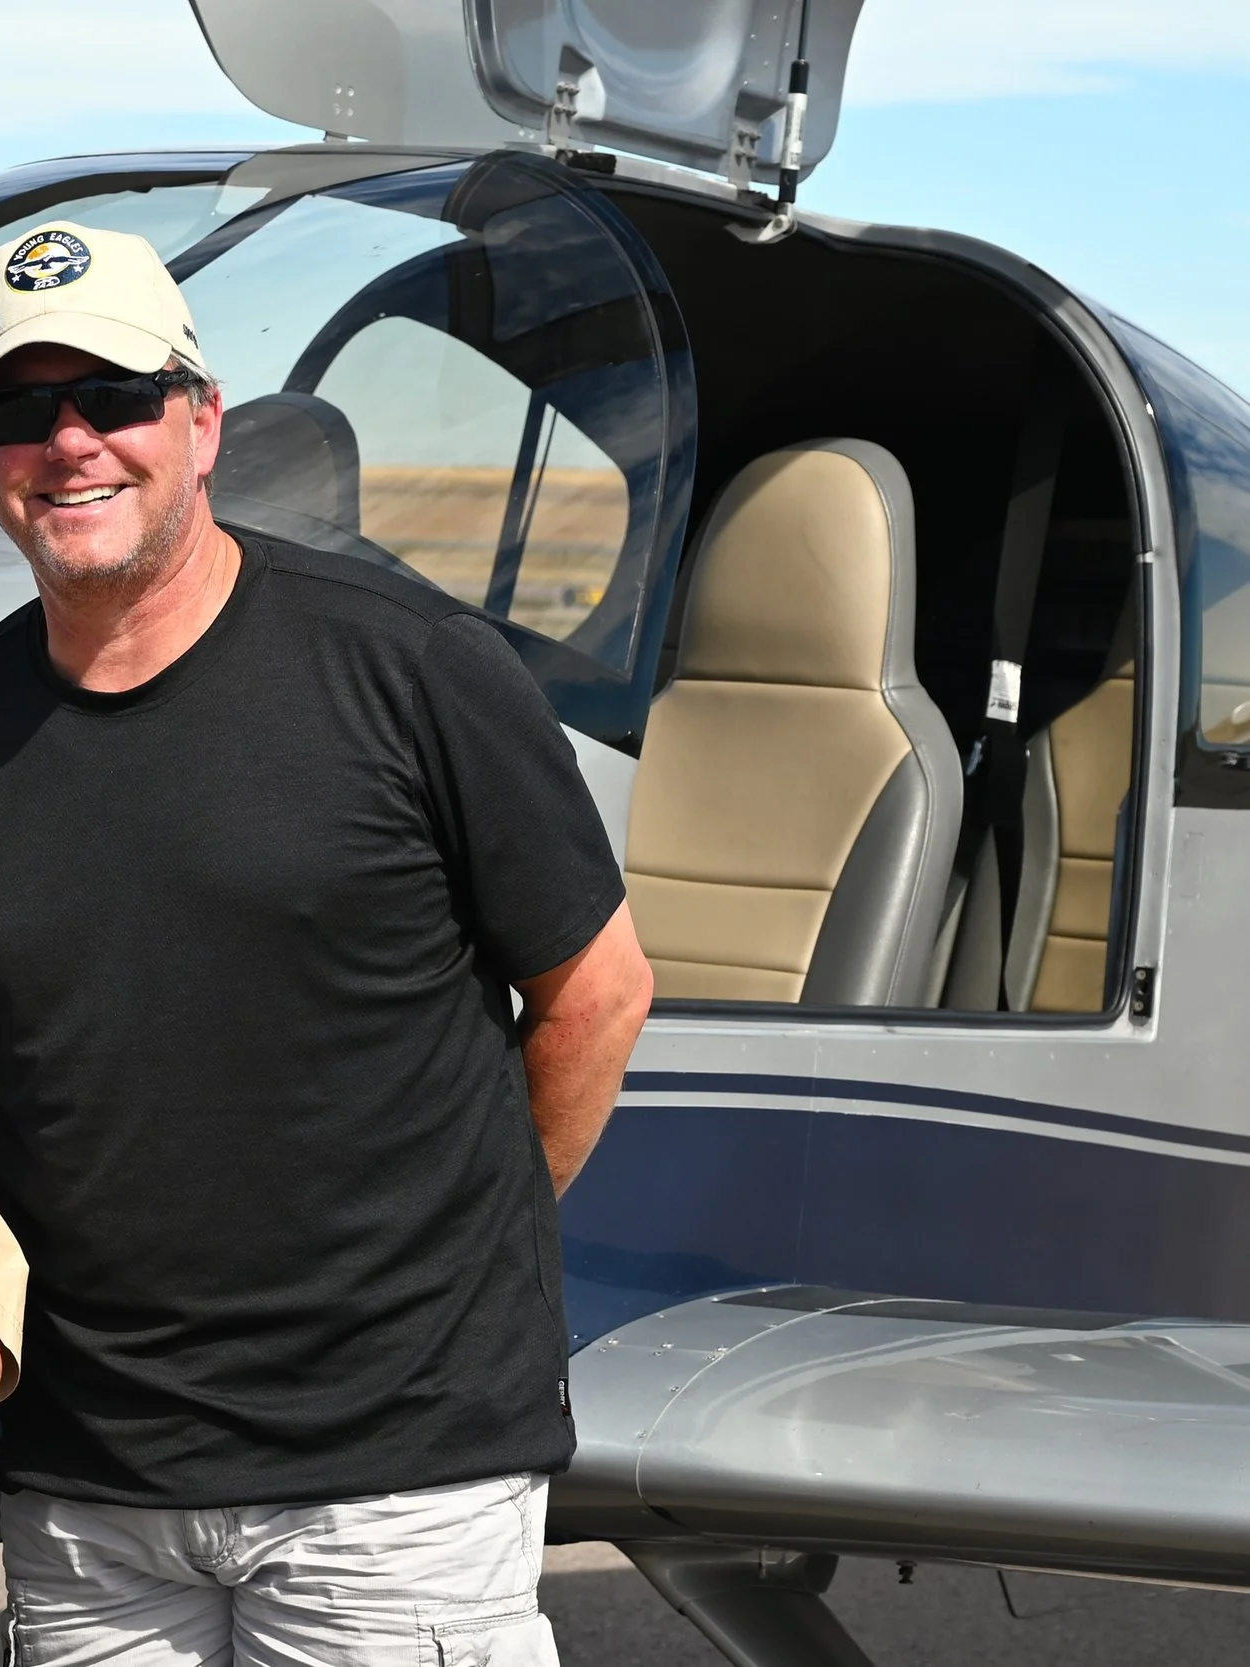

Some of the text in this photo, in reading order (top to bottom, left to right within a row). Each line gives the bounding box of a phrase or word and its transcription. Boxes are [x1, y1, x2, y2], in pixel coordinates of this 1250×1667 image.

[14, 233, 84, 260] YOUNG EAGLES
[558, 1380, 566, 1406] GERRY
